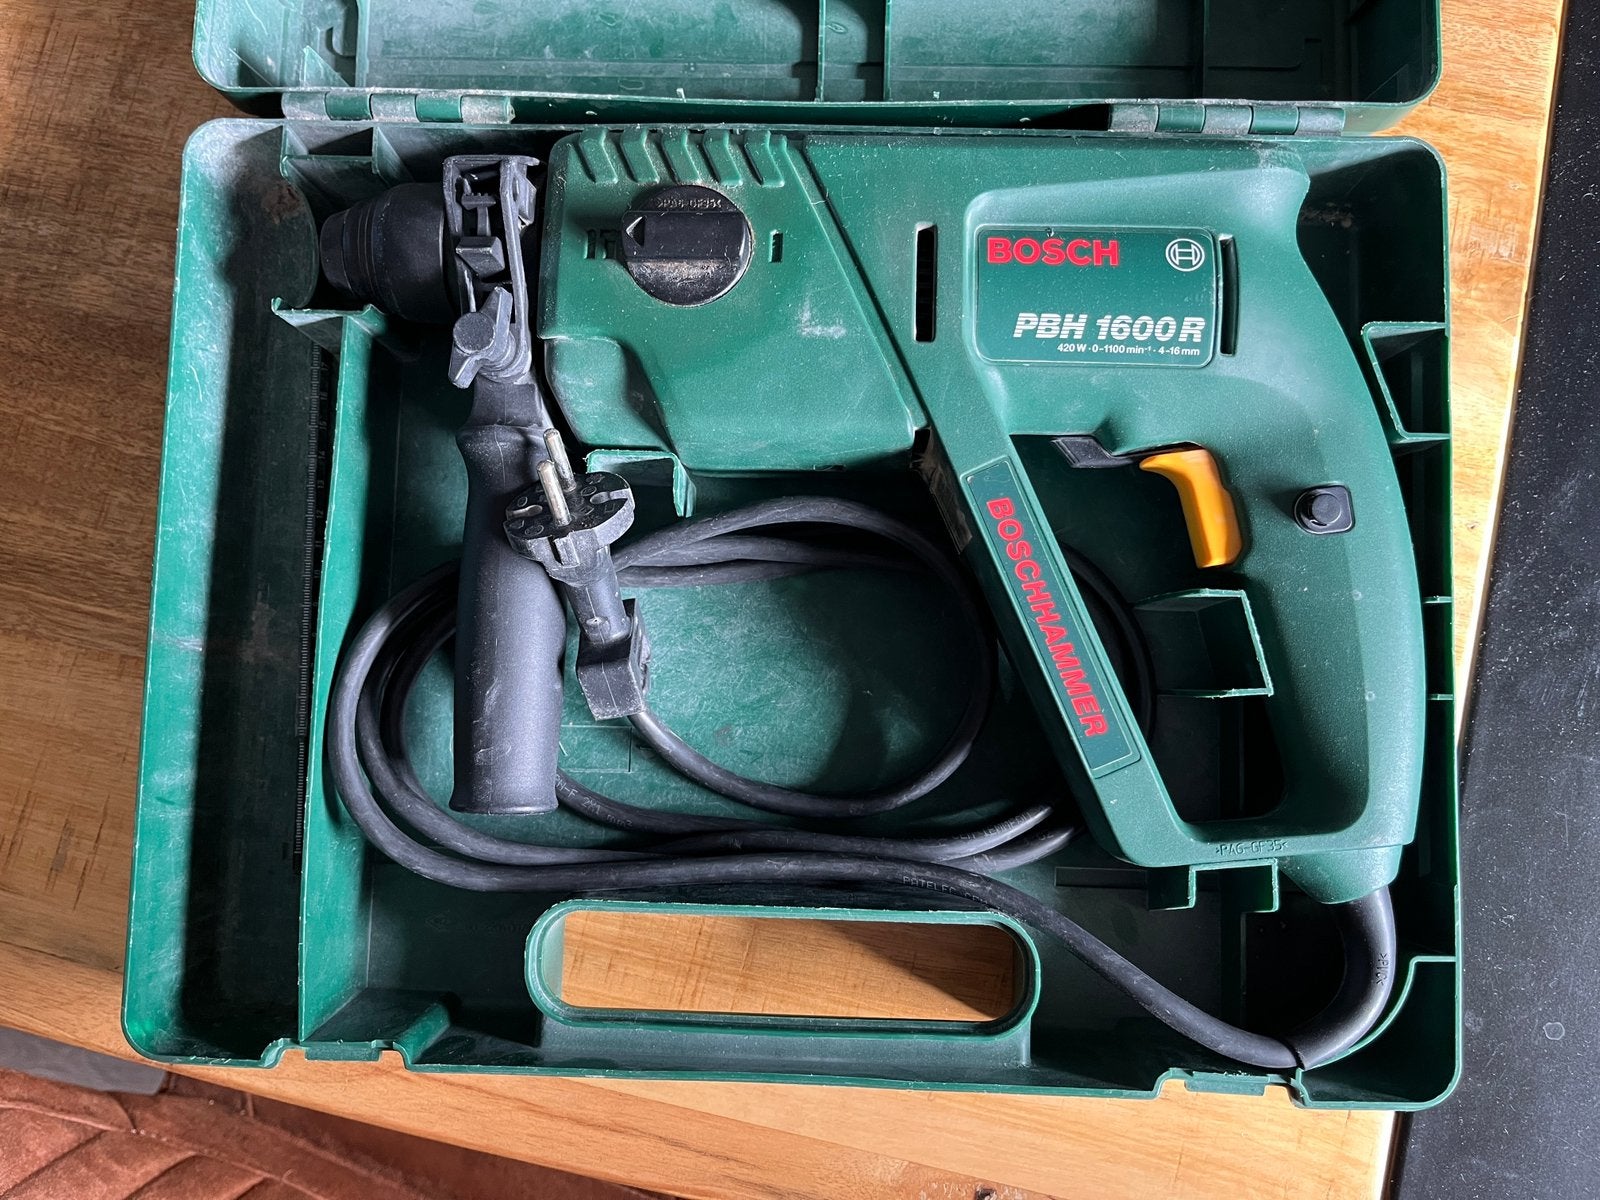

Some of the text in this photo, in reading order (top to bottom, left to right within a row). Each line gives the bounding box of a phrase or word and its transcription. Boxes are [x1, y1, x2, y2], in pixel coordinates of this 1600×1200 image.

[986, 237, 1120, 267] BOSCH
[1013, 312, 1088, 339] PBH
[1181, 347, 1200, 356] mm
[986, 497, 1109, 738] BOSCHHAMMER
